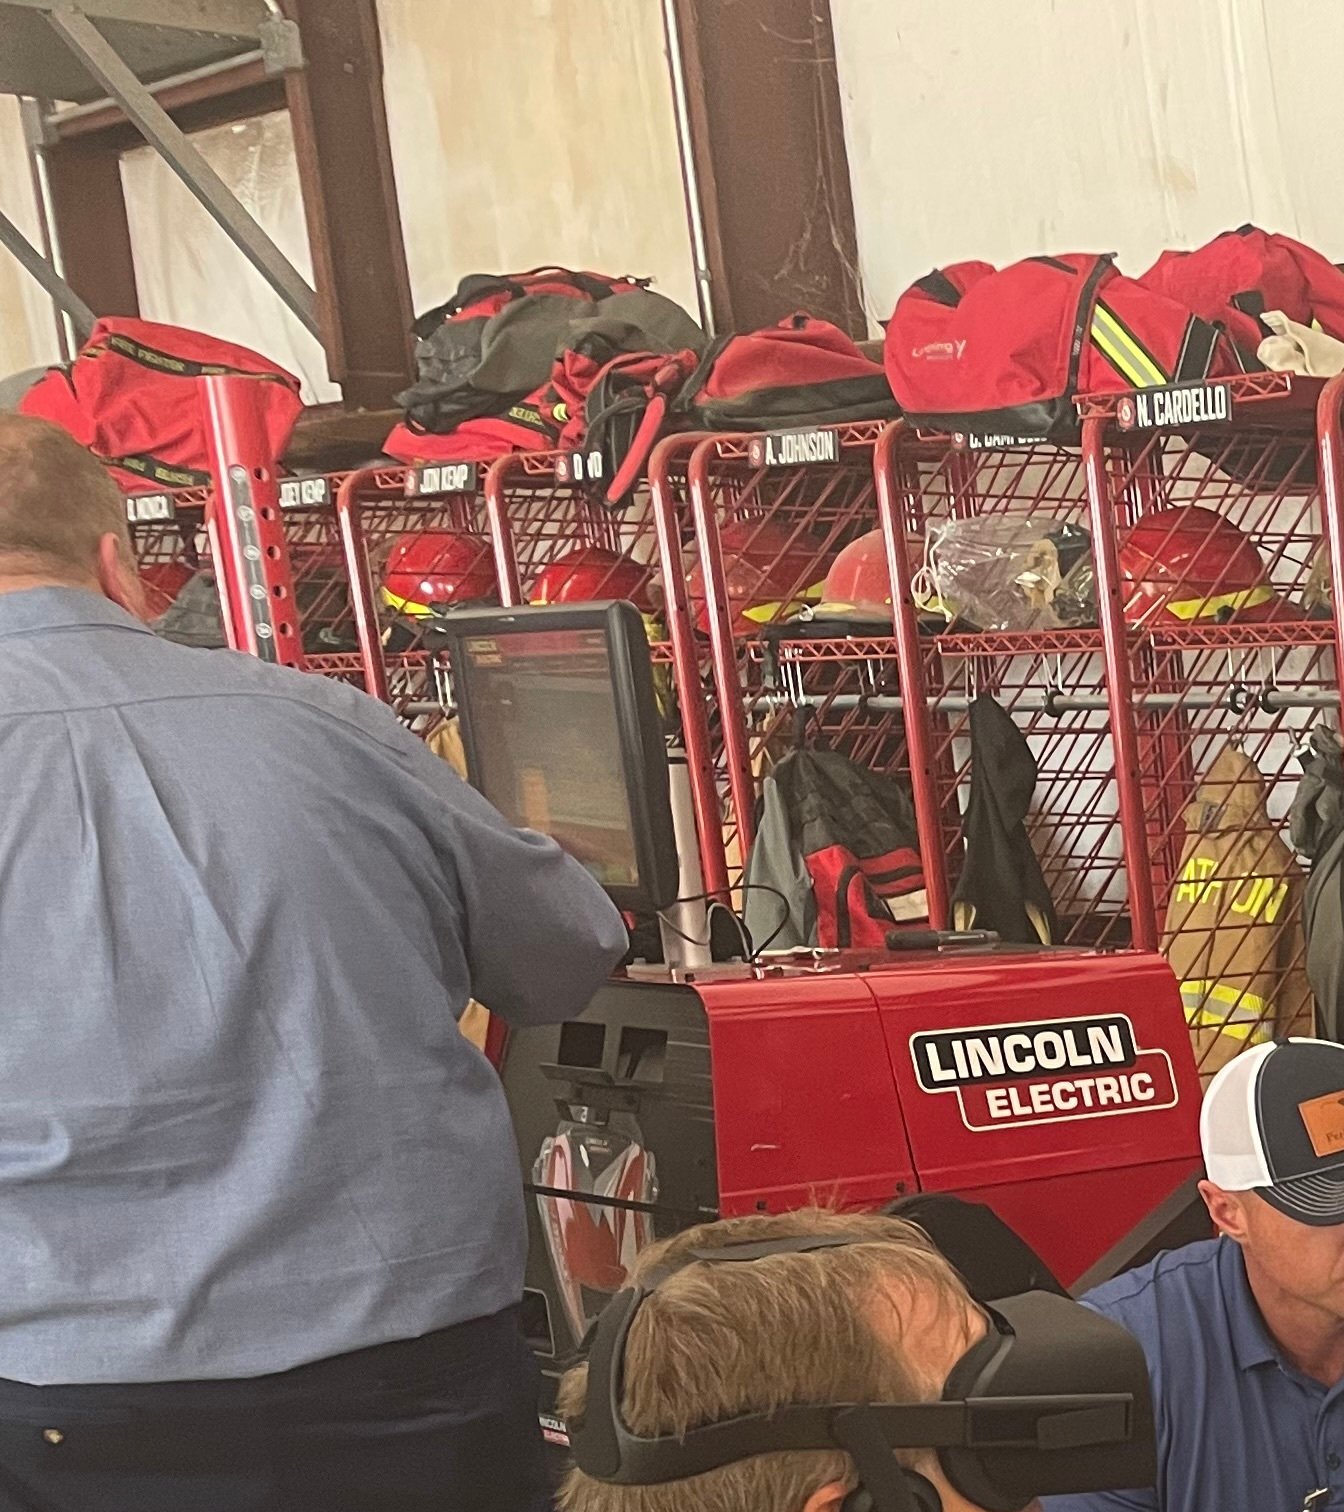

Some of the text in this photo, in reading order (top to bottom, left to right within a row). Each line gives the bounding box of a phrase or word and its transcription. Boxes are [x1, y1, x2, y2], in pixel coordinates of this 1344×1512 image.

[1136, 385, 1226, 428] N. CARDELLO
[765, 431, 834, 465] A. JOHNSON
[925, 1024, 1126, 1082] LINCOLN
[985, 1072, 1155, 1119] ELECTRIC
